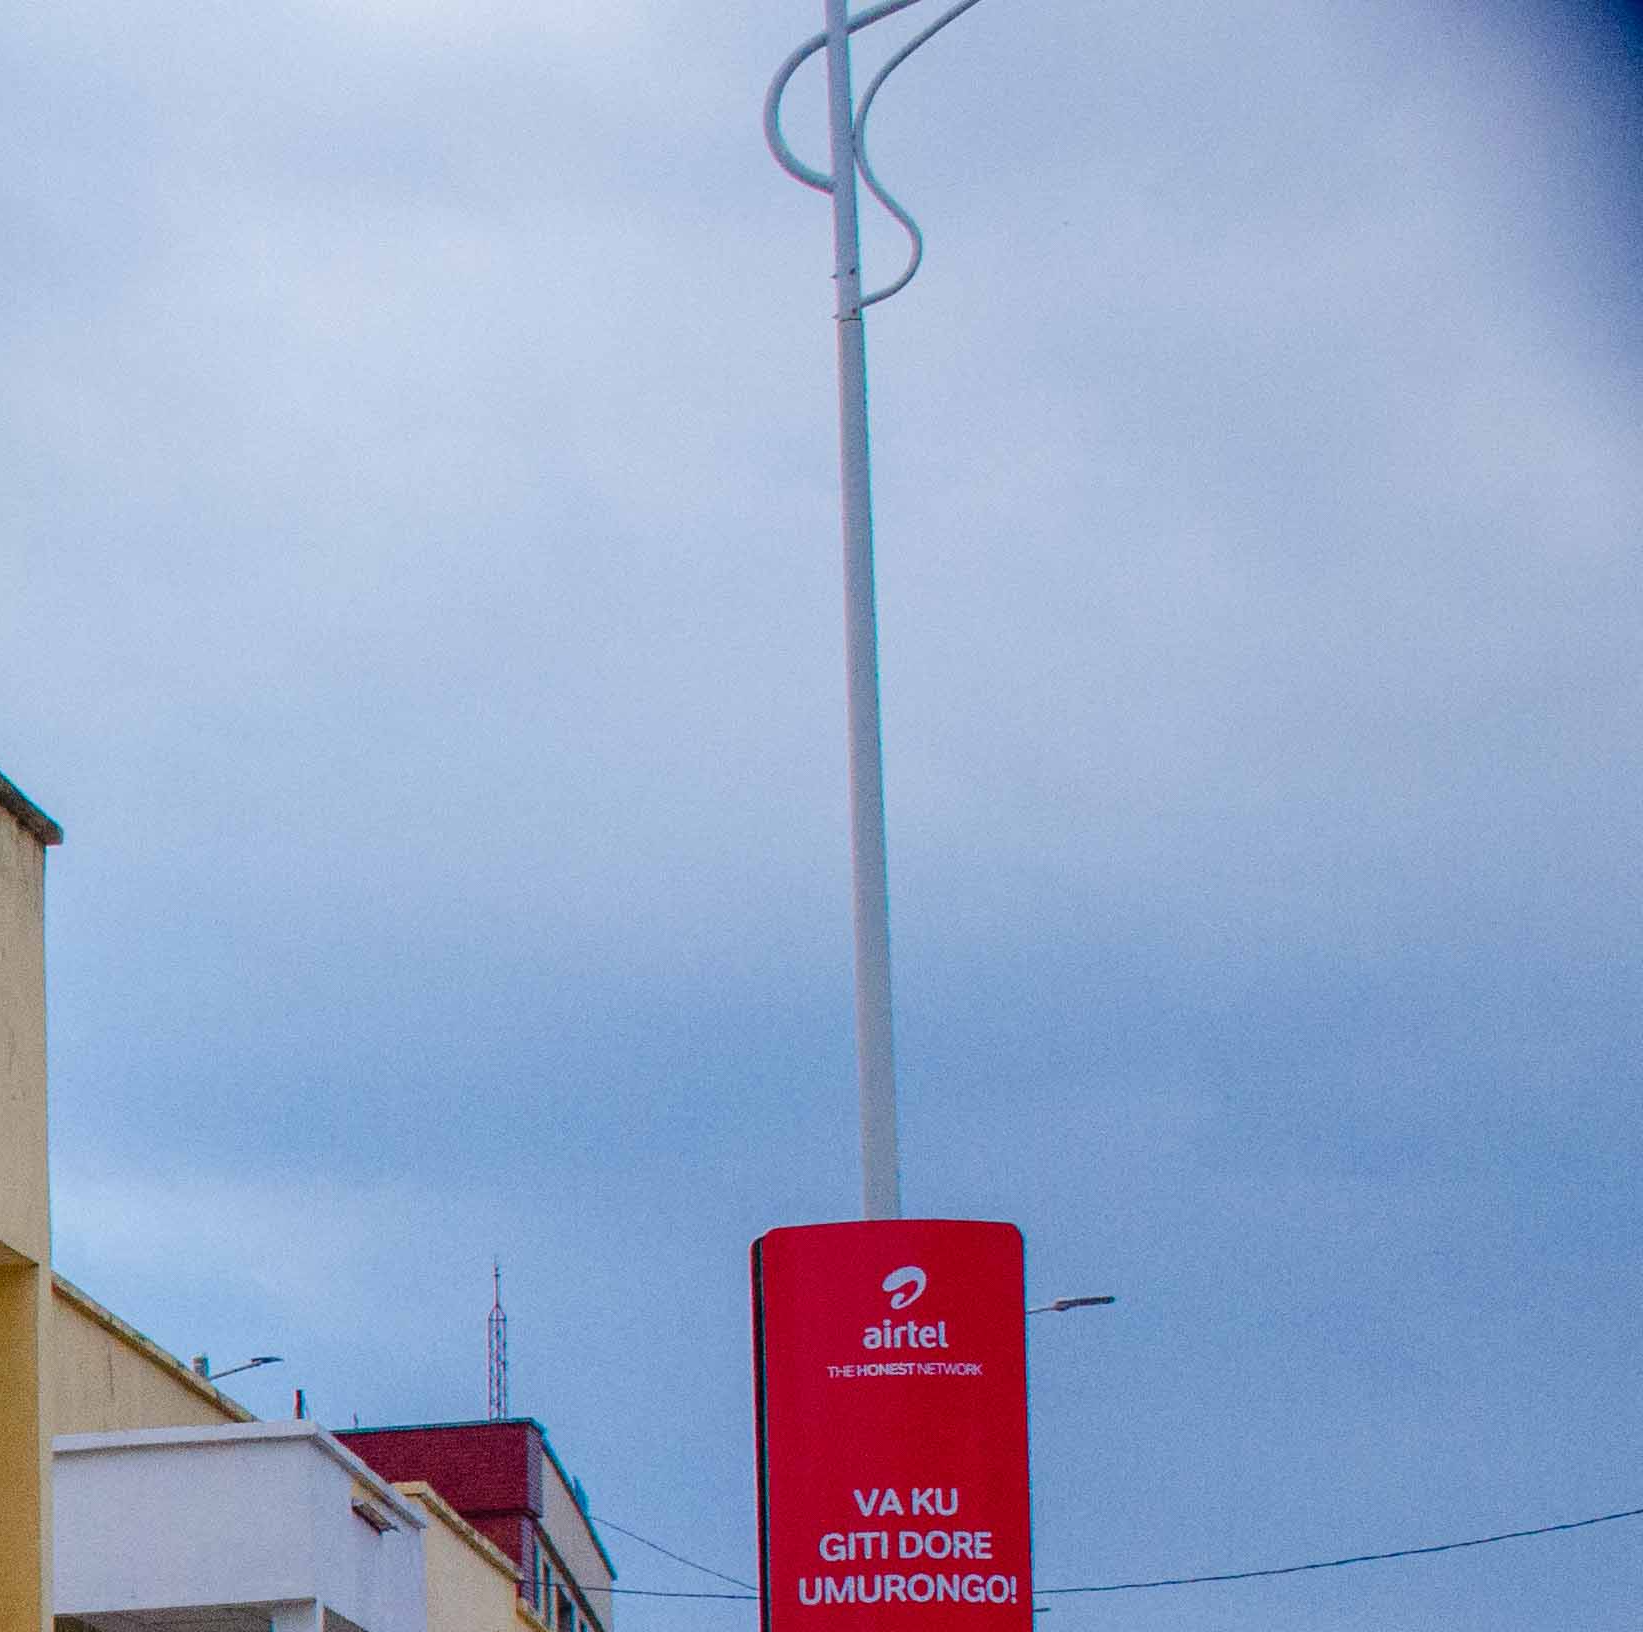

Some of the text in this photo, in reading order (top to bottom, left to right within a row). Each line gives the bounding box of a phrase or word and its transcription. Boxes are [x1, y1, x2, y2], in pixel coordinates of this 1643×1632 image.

[862, 1320, 949, 1350] airtel
[827, 1362, 983, 1378] THE HONEST NETWORK
[853, 1487, 958, 1517] VA KU
[819, 1531, 993, 1562] GITI DORE
[798, 1574, 1018, 1606] UMURONGO!
